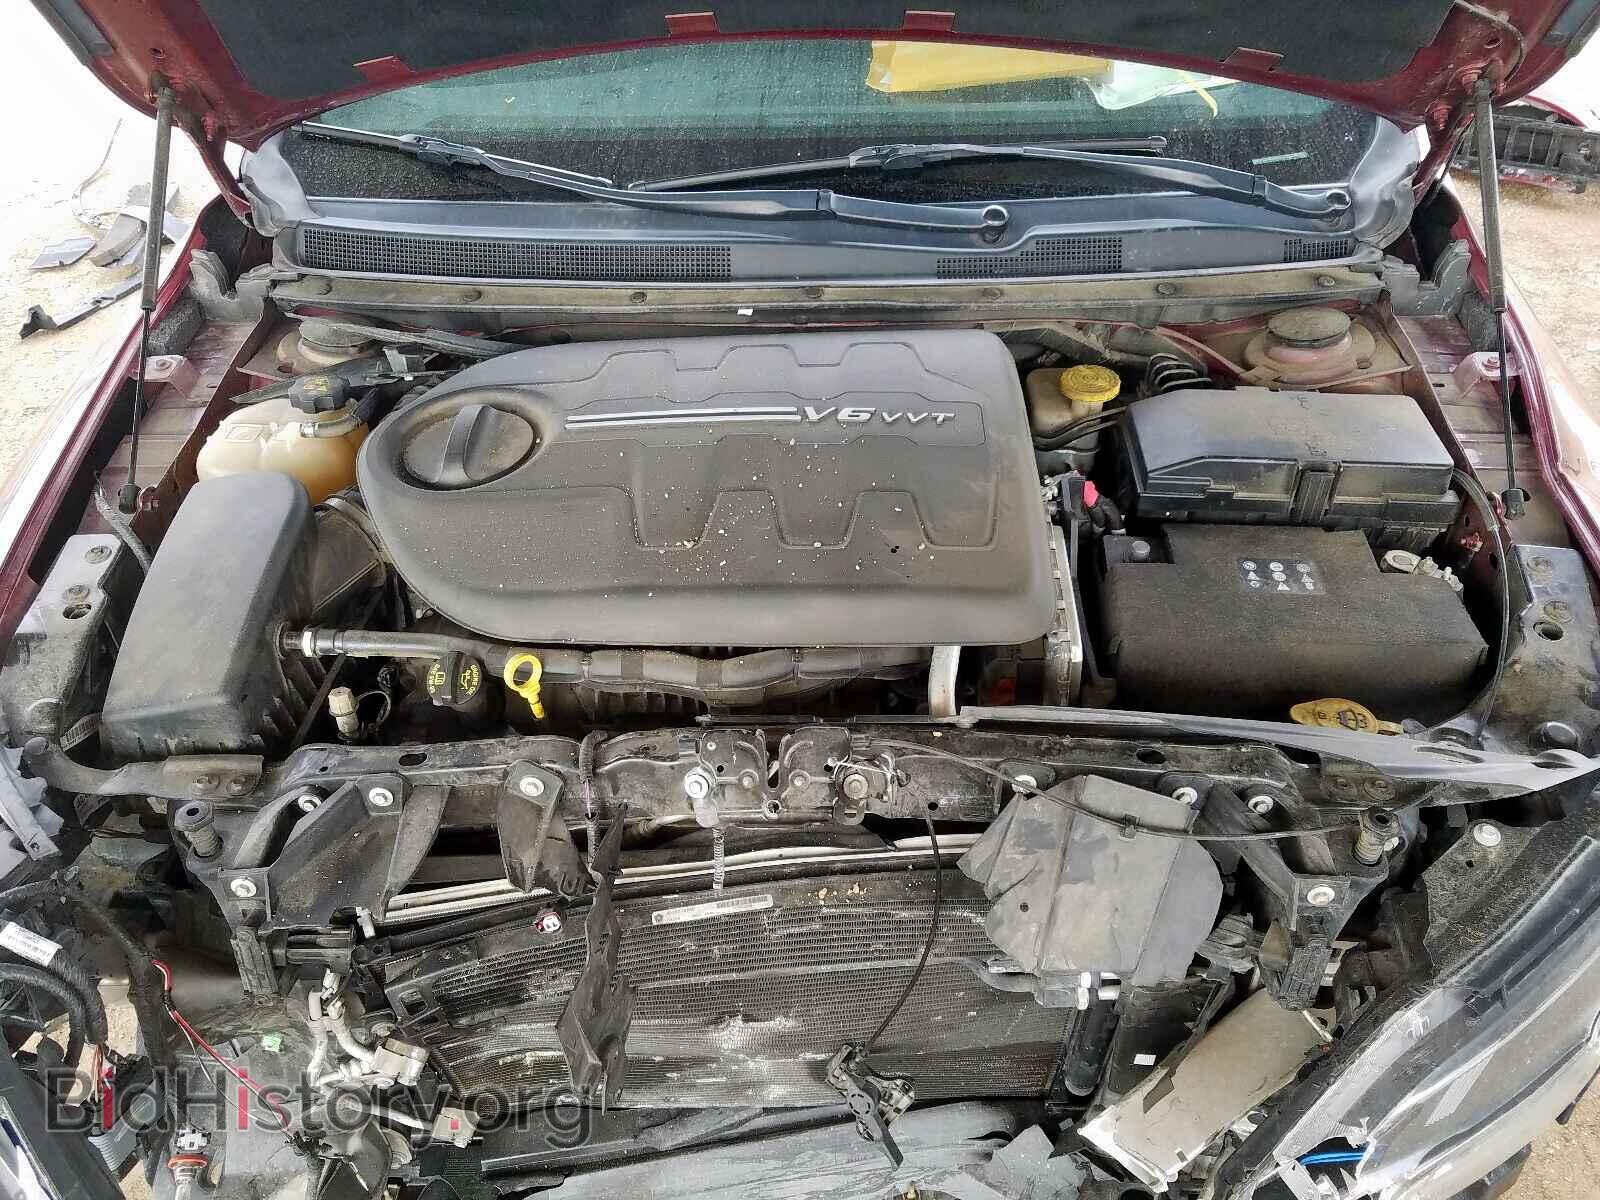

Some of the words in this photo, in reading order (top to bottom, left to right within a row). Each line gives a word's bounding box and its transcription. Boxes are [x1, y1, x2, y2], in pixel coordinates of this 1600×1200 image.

[804, 406, 876, 423] V6
[881, 411, 956, 425] VVT
[470, 664, 480, 686] ENGINE
[465, 686, 476, 696] OIL
